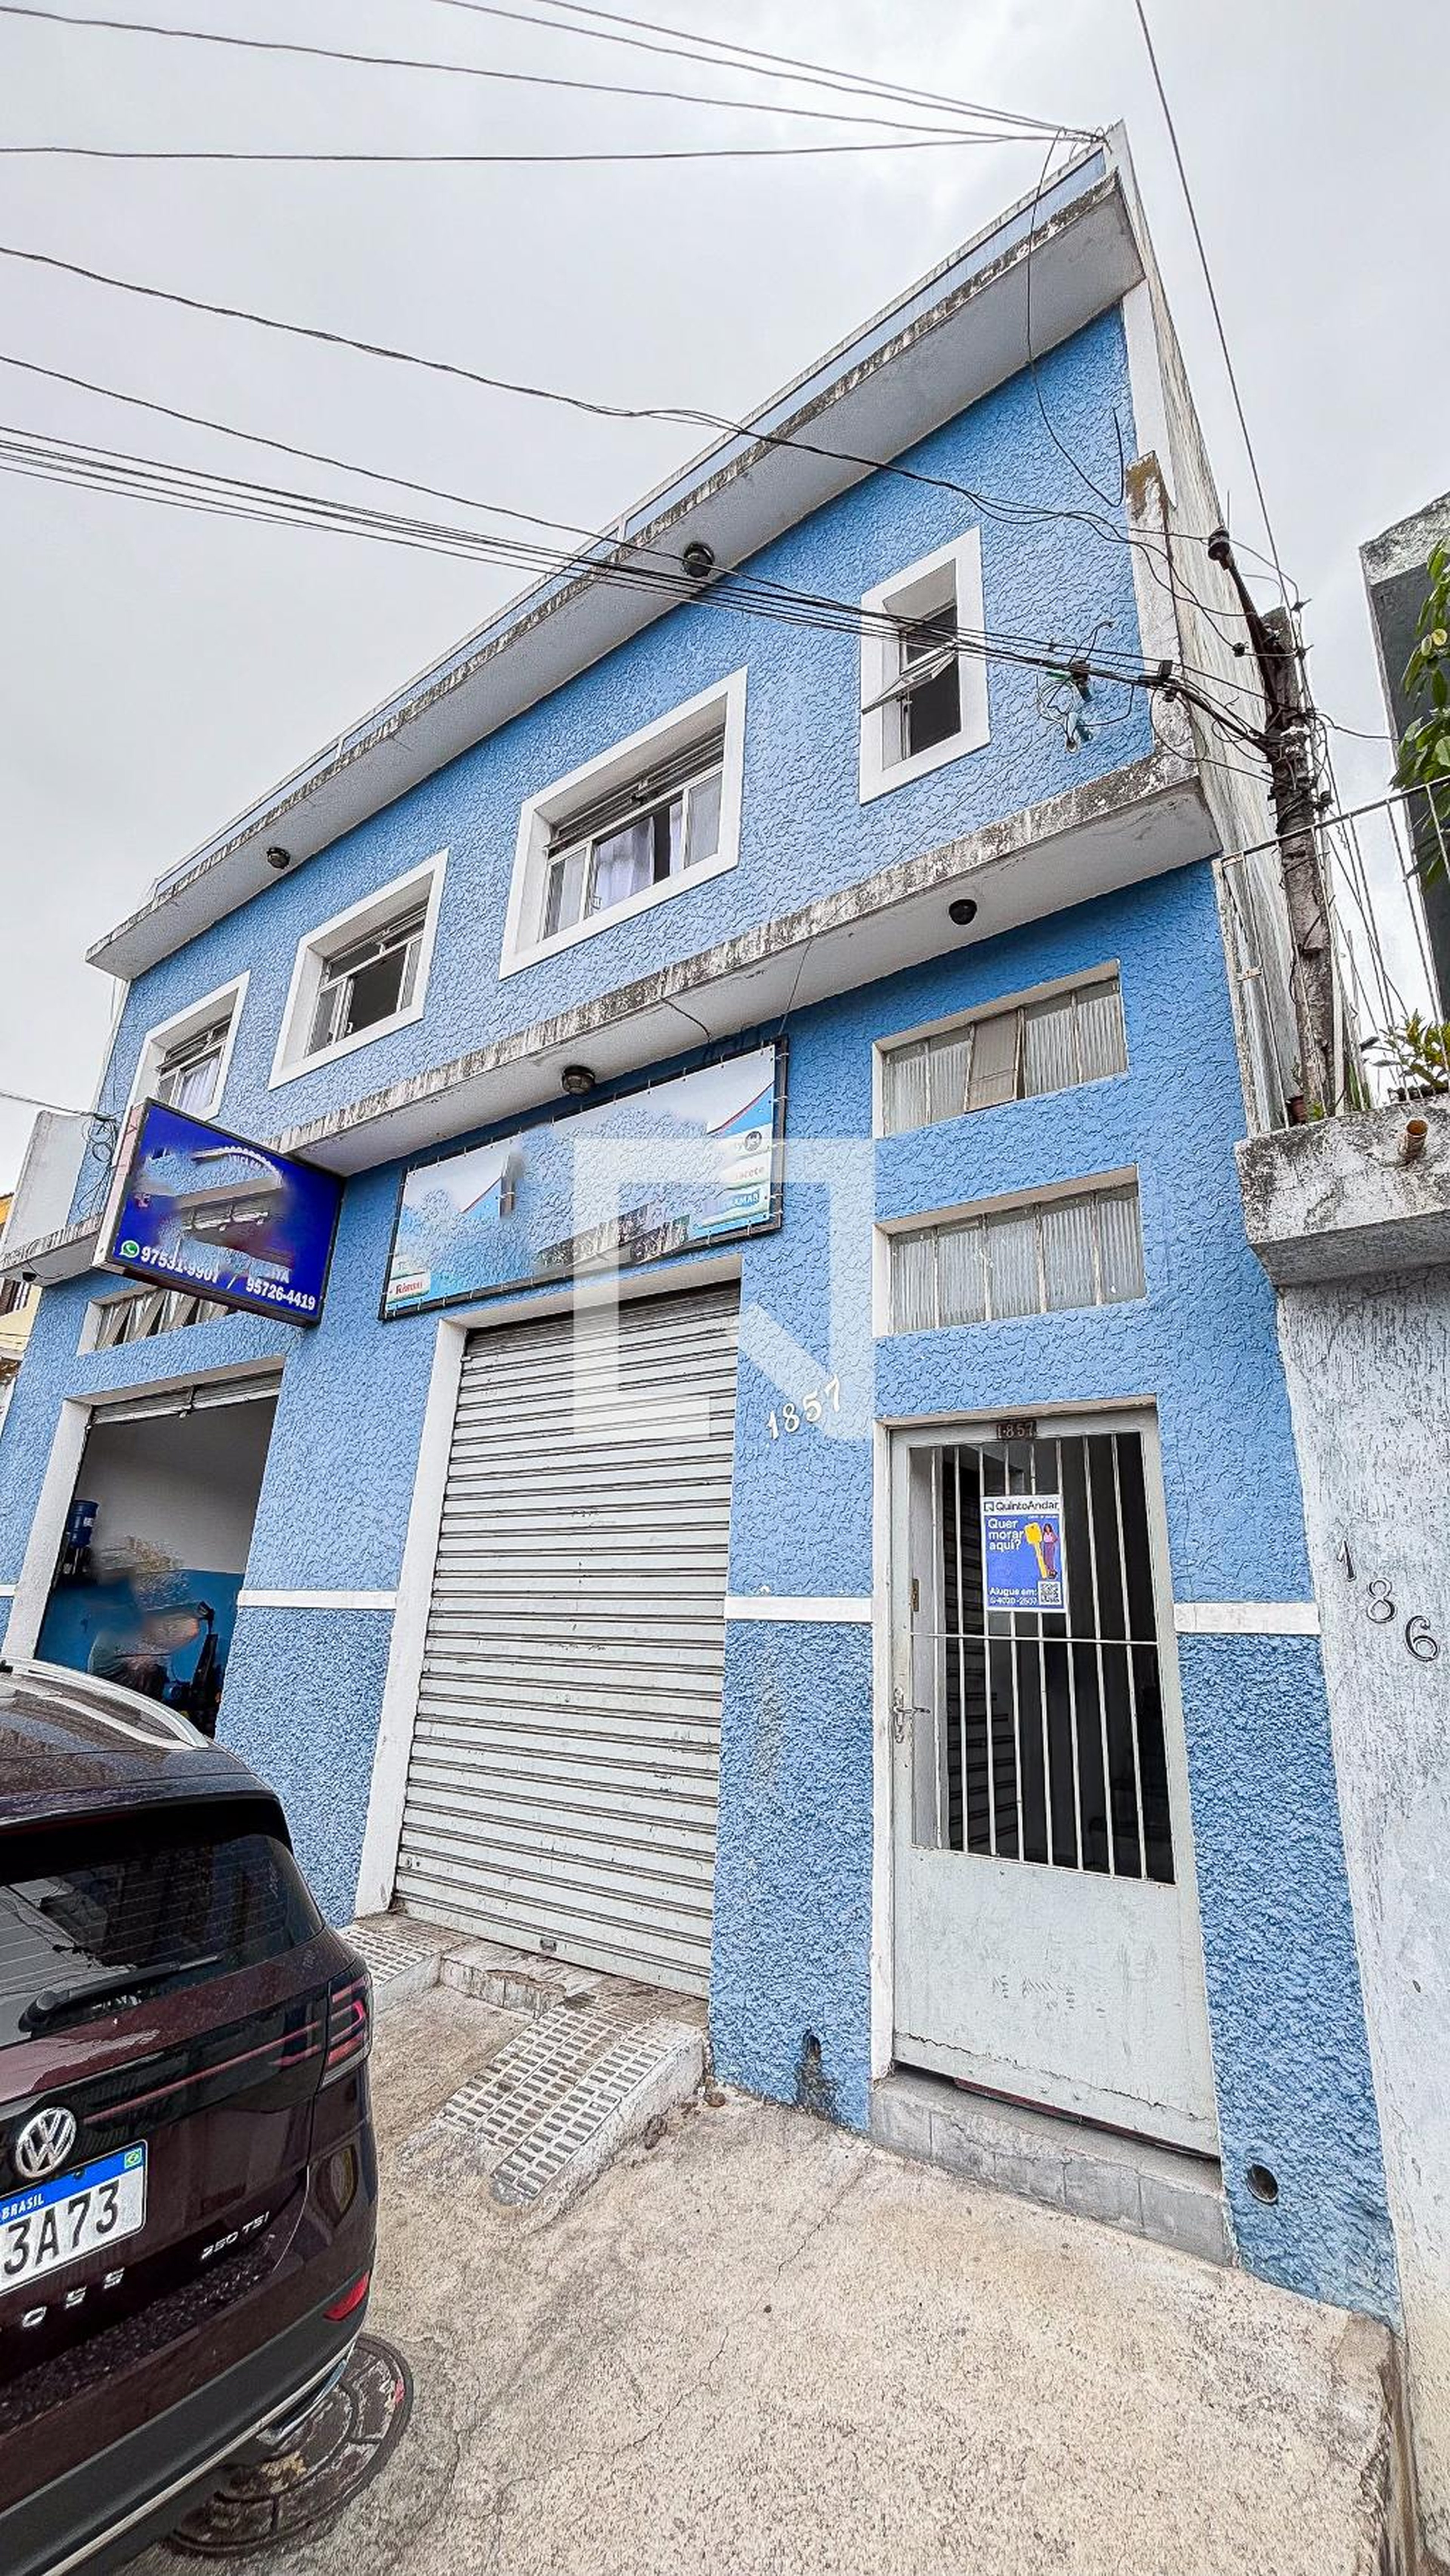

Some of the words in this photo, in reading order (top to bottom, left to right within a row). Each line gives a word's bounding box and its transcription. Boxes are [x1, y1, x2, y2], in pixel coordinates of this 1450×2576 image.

[765, 1373, 841, 1440] 1857
[996, 1500, 1058, 1510] QuintoAndar
[988, 1518, 1018, 1529] Quer
[989, 1530, 1024, 1540] morar
[989, 1539, 1021, 1552] aqui?
[990, 1587, 1020, 1596] Alugue
[1336, 1539, 1440, 1662] 186
[2, 2193, 44, 2219] BRASIL
[4, 2179, 120, 2275] 3A73
[242, 2210, 270, 2234] TSI
